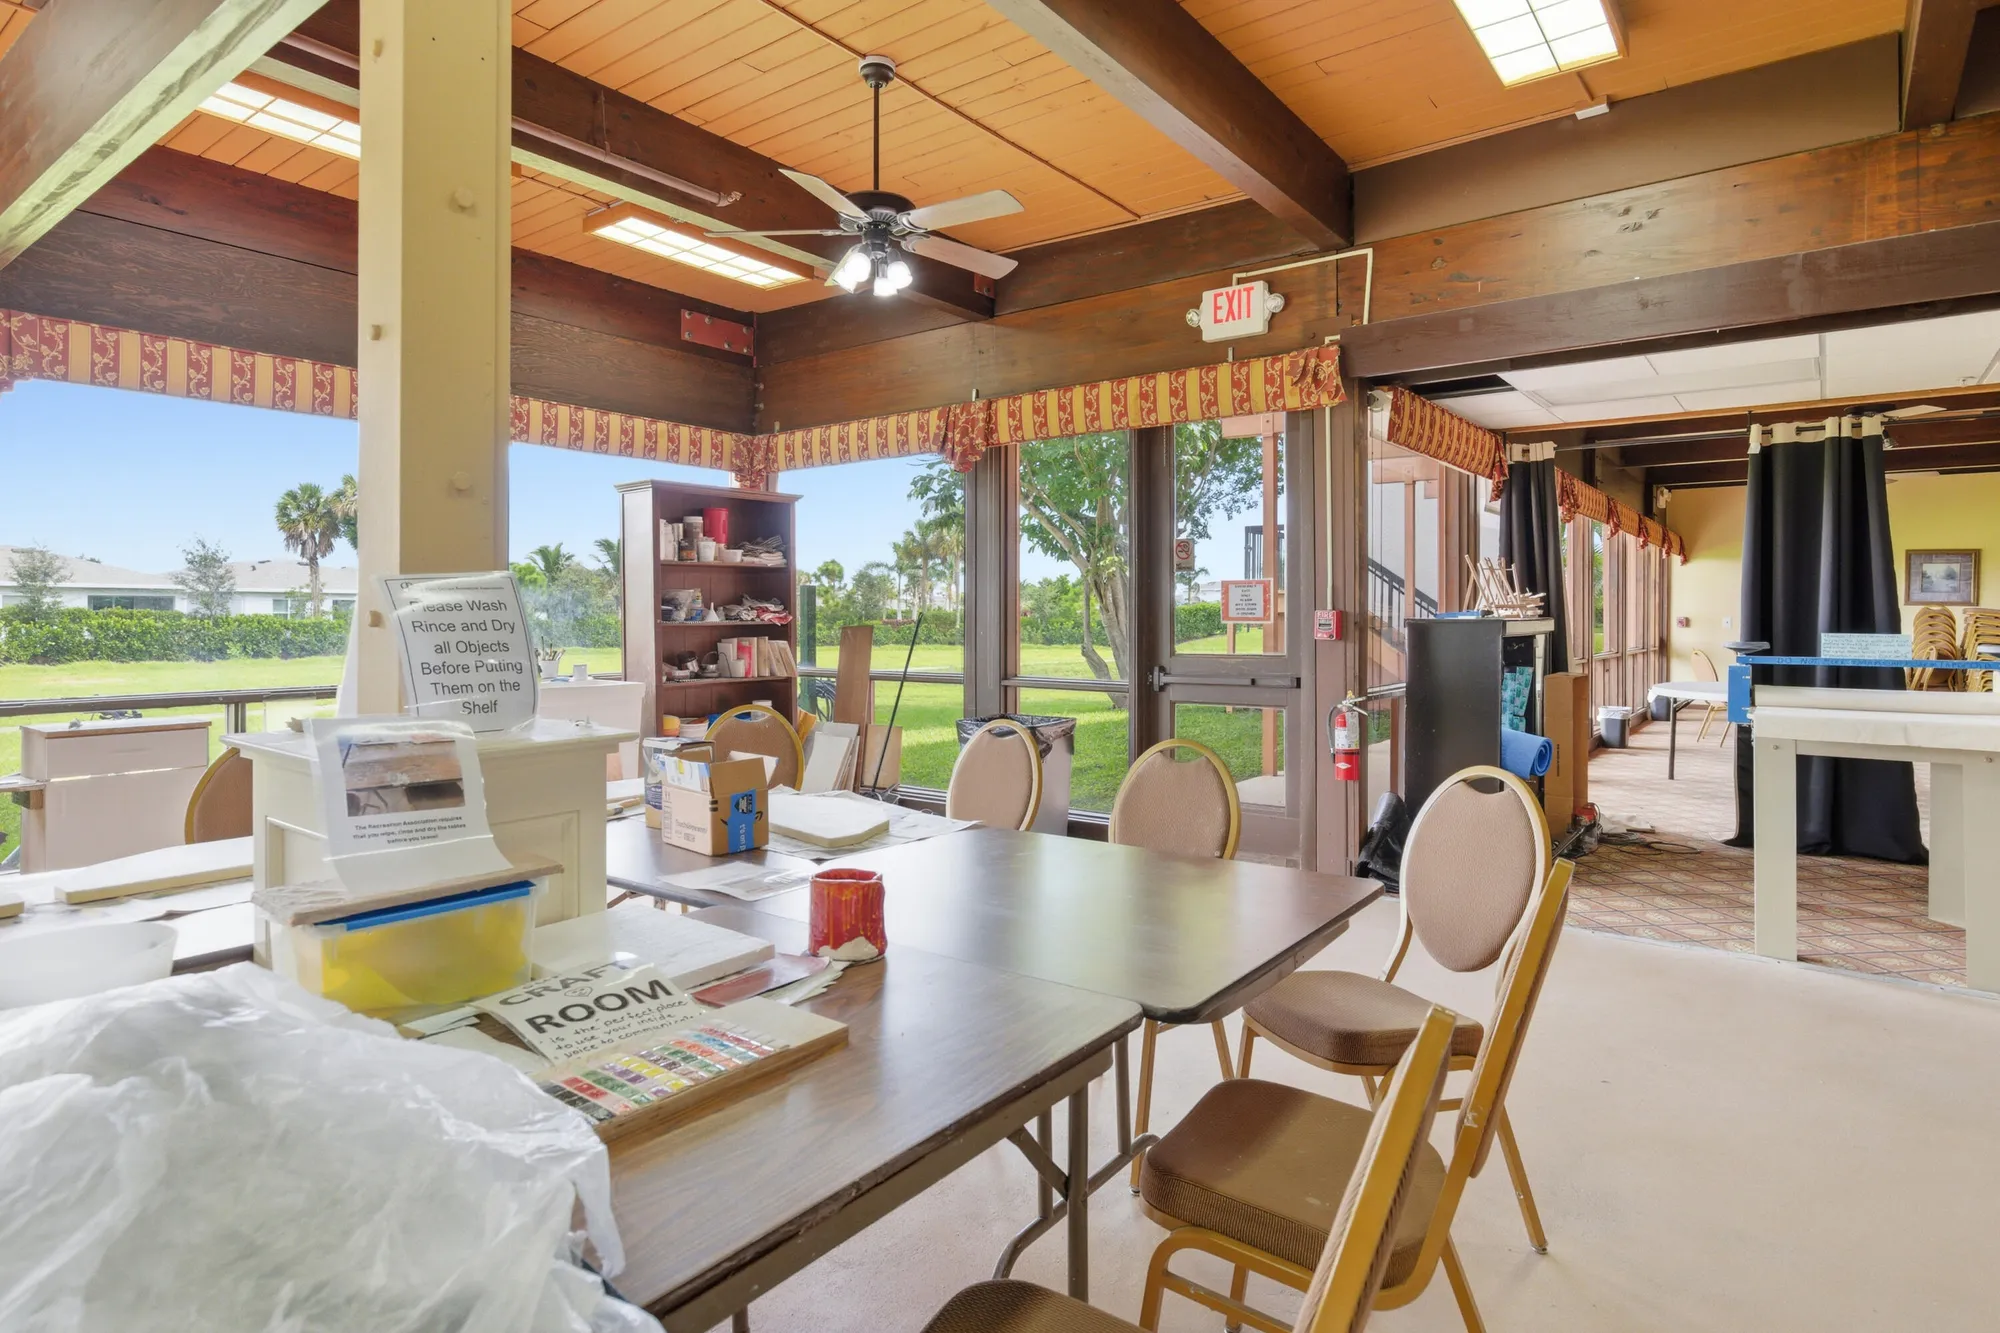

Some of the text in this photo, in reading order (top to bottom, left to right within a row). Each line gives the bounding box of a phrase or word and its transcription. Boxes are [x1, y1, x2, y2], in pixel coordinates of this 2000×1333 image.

[1213, 286, 1255, 324] EXIT
[466, 599, 508, 612] Wash
[411, 619, 515, 634] Rince and Dry
[434, 640, 510, 656] all Objects
[420, 659, 523, 675] Before Putting
[430, 679, 521, 695] Them on the
[462, 700, 498, 714] Shelf
[403, 818, 438, 827] Association
[525, 979, 674, 1034] ROOM
[550, 1000, 688, 1044] is the perfect place
[556, 1013, 676, 1051] to use your inside
[564, 1044, 599, 1058] voice
